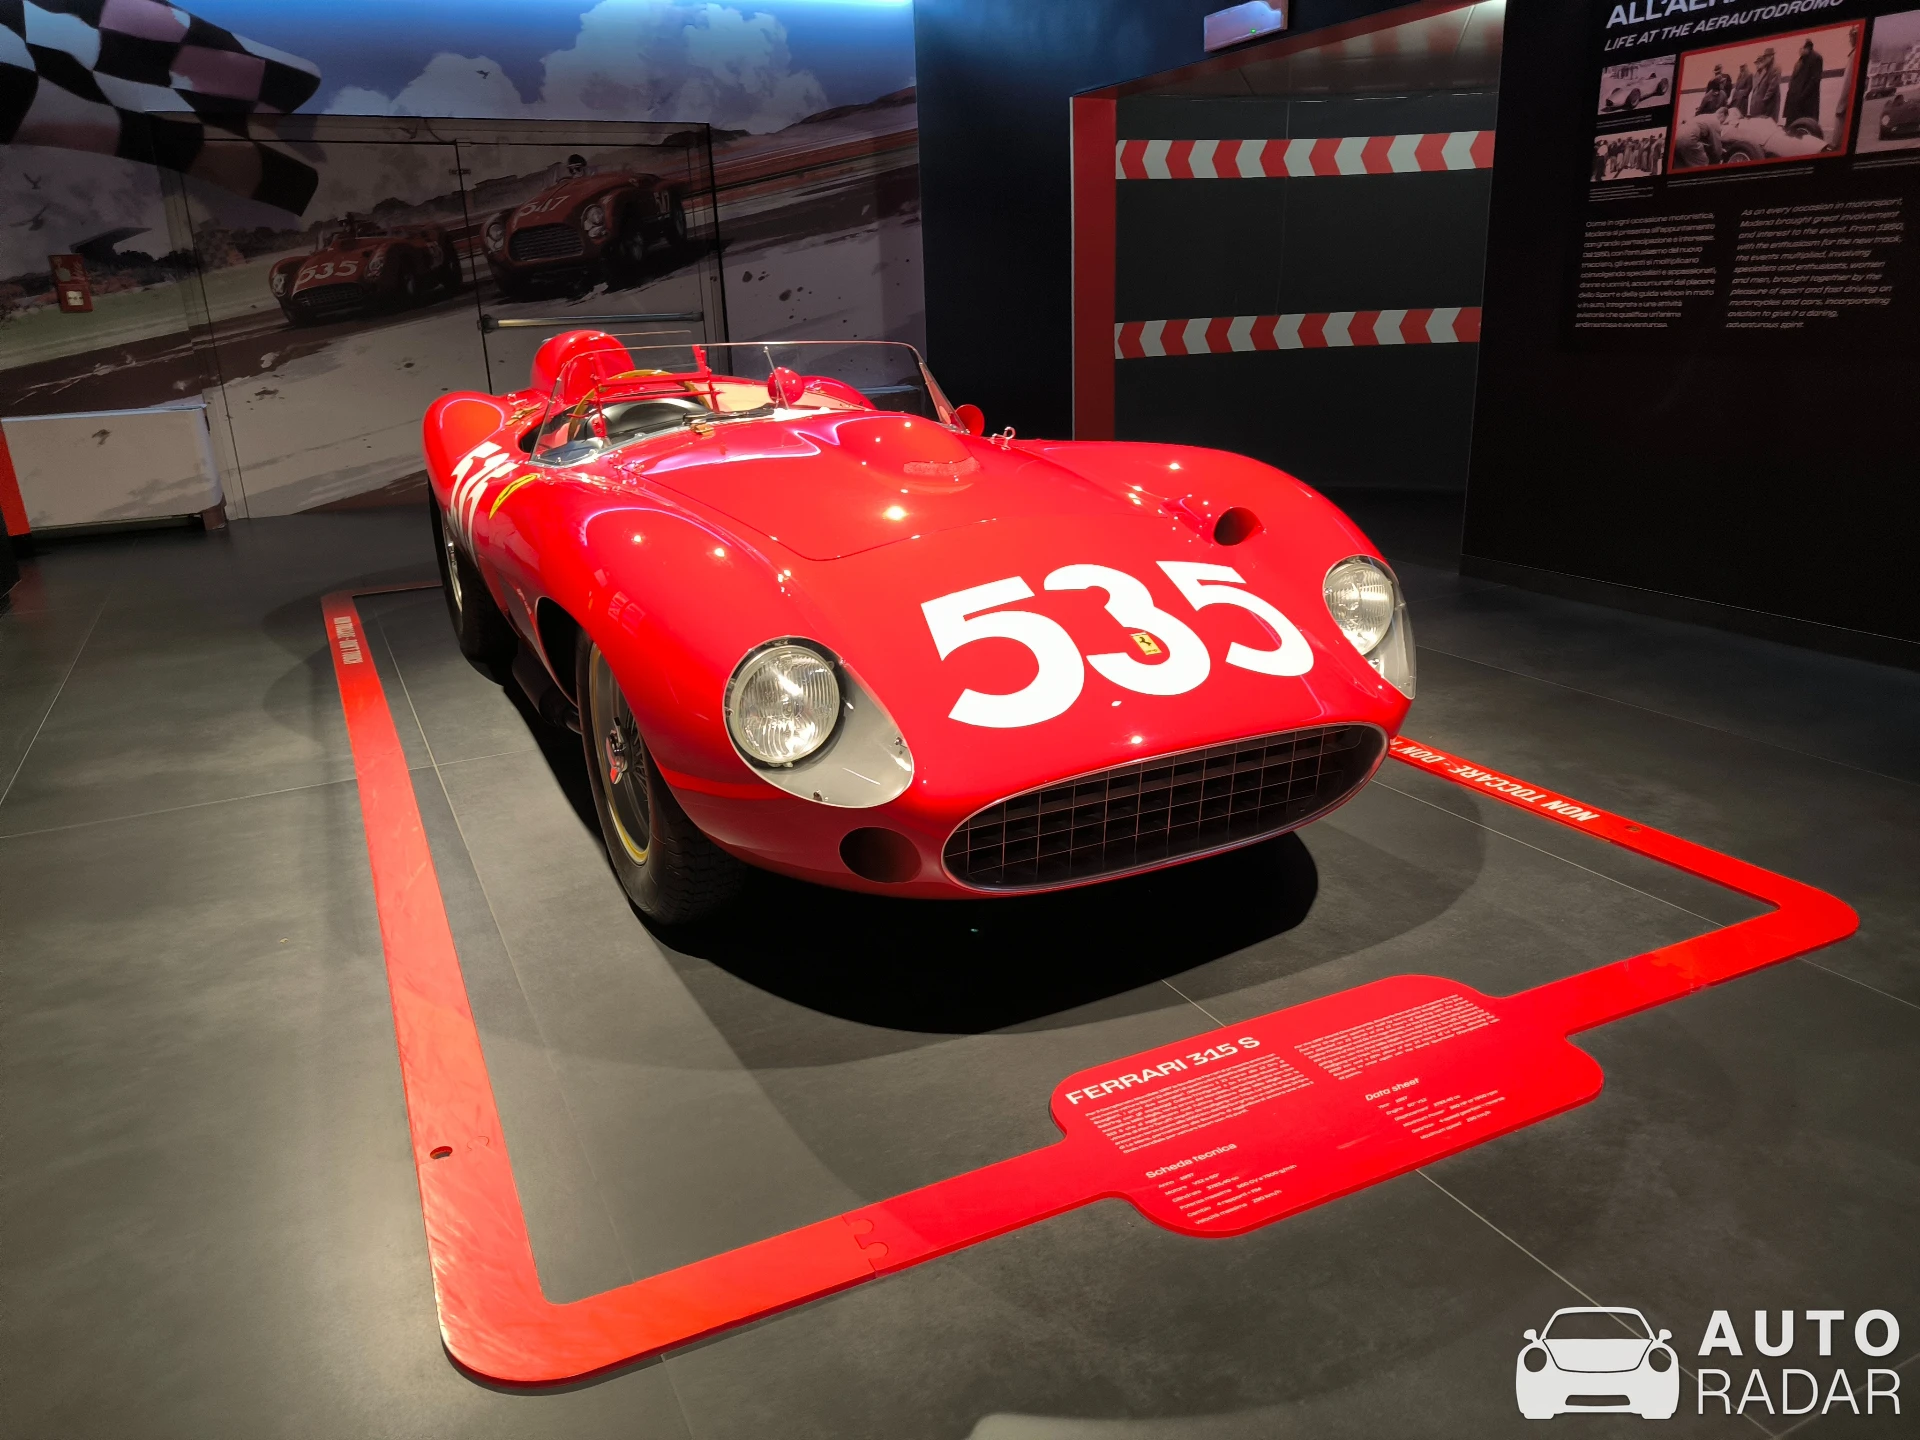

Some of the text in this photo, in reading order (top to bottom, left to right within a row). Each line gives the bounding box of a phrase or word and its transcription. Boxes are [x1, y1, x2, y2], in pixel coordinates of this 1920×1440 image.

[1604, 0, 1843, 52] LIFE AT THE AERAUTODROMO
[1792, 204, 1834, 212] occasion
[1812, 215, 1840, 224] great
[1840, 212, 1900, 220] involvement
[299, 259, 359, 285] 535
[1823, 286, 1843, 294] fast
[921, 561, 1314, 728] 535
[1447, 765, 1546, 803] TOCCARE
[1541, 800, 1600, 821] NON
[1065, 1036, 1261, 1105] FERRARI 315 S
[1365, 1077, 1420, 1101] Data sheet
[1145, 1143, 1237, 1179] Scheda tecnica
[1158, 1180, 1175, 1188] Anno
[1179, 1199, 1204, 1210] Potenza
